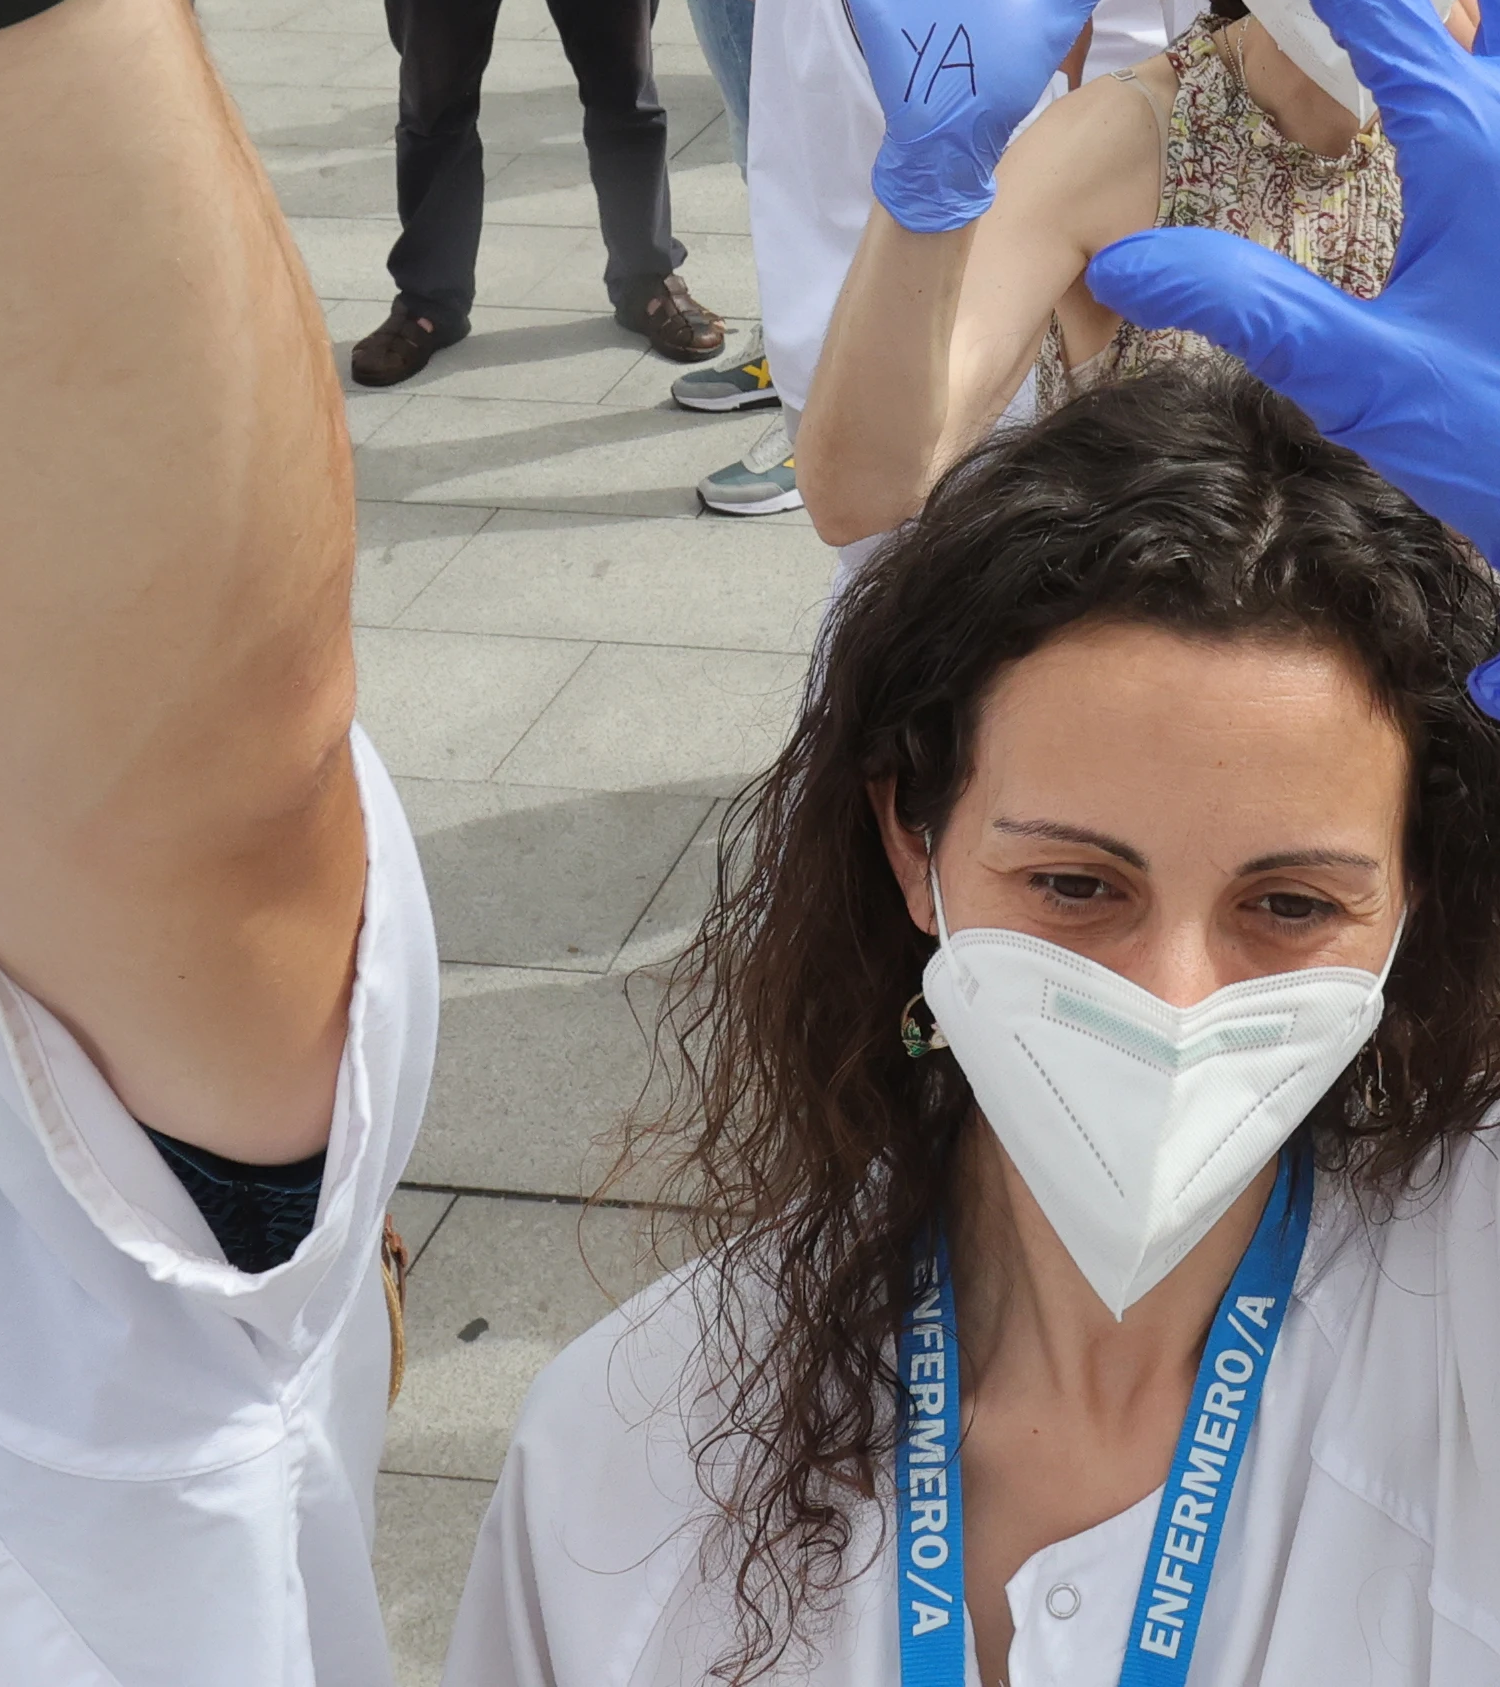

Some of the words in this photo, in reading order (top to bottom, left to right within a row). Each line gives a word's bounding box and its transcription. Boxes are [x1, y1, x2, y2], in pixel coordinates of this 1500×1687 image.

[900, 21, 978, 105] YA
[906, 1255, 953, 1637] ENFERMERO/A
[1138, 1292, 1277, 1662] ENFERMERO/A
